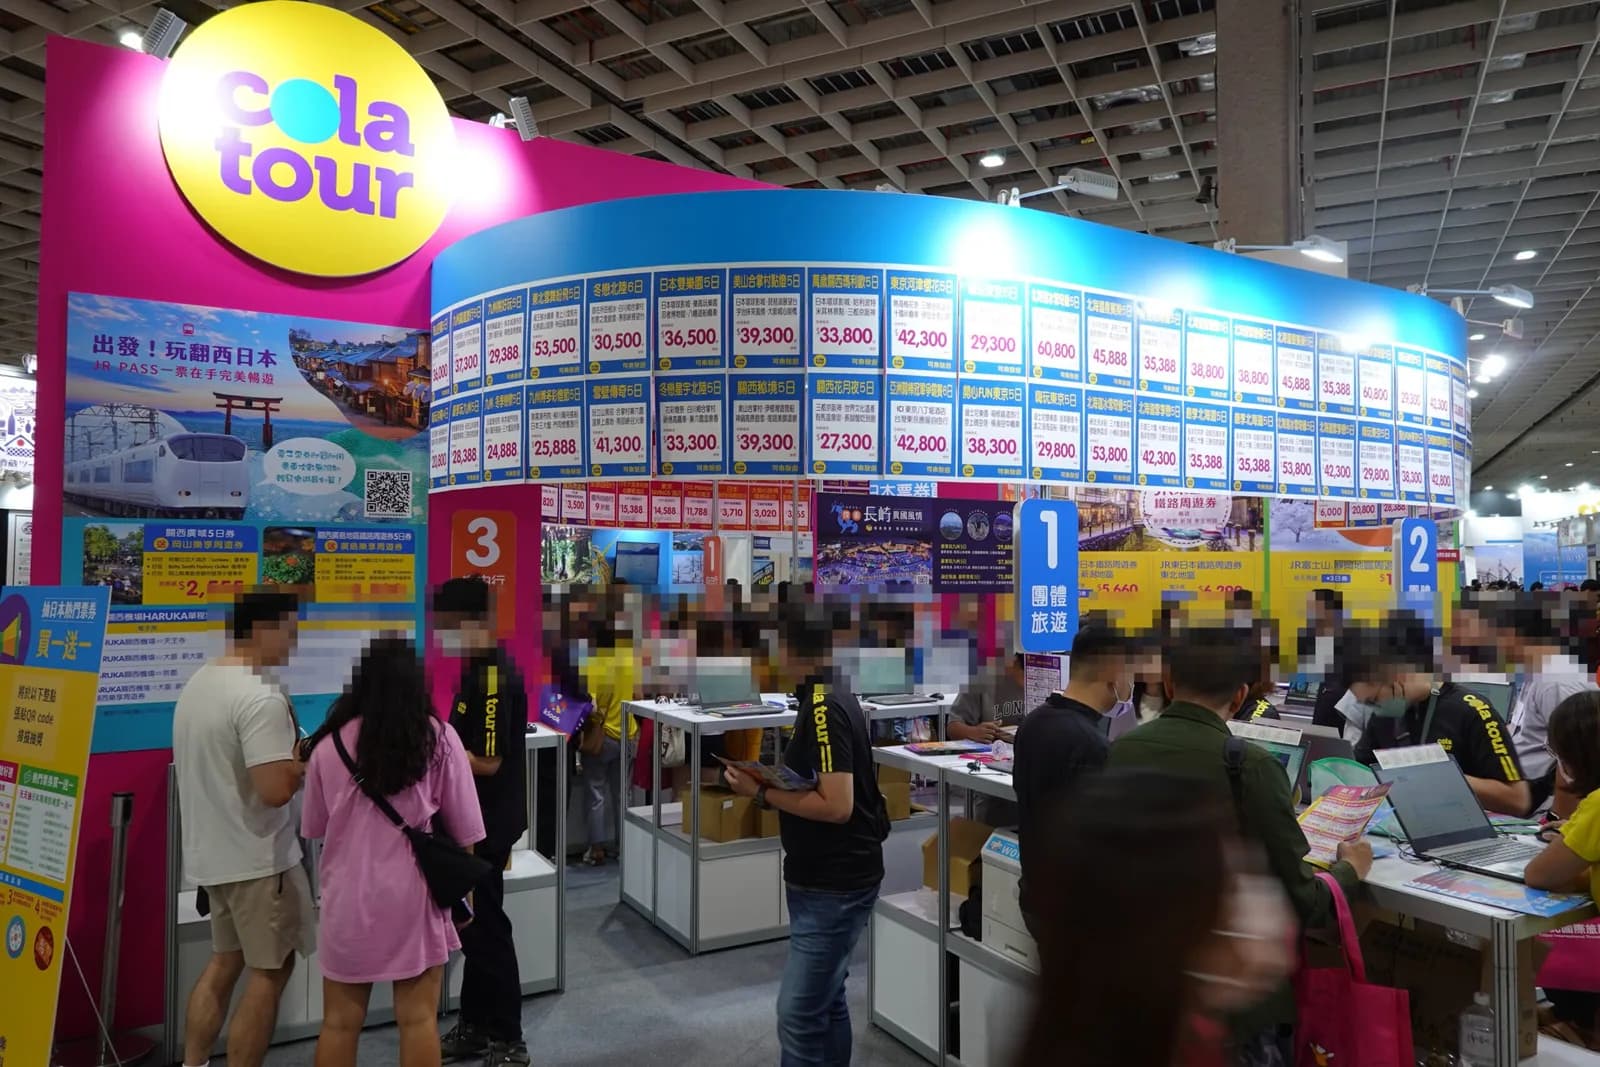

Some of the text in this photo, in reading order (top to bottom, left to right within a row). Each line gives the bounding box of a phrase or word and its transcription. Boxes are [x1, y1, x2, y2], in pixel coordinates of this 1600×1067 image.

[216, 70, 415, 157] cola
[214, 126, 414, 219] tour
[594, 331, 642, 350] 30,500
[664, 328, 717, 347] 36,500
[740, 326, 794, 346] 39,300
[819, 326, 874, 345] 33,800
[897, 329, 948, 348] 42,300
[970, 334, 1016, 353] 29,300
[92, 334, 278, 368] 出發！玩翻西日本
[489, 344, 519, 364] 29,388
[534, 337, 576, 357] 53,500
[1037, 340, 1076, 359] 60,800
[1093, 347, 1127, 366] 45,888
[93, 360, 111, 372] JR
[455, 353, 478, 374] 37,300
[1144, 355, 1176, 373] 35,388
[1191, 362, 1224, 380] 38,800
[1238, 369, 1269, 386] 38,800
[1282, 375, 1310, 391] 45,888
[1322, 379, 1351, 396] 35,388
[1363, 385, 1388, 401] 60,800
[487, 442, 517, 461] 24,888
[534, 438, 576, 457] 25,888
[595, 435, 642, 455] 41,300
[666, 433, 717, 453] 33,300
[740, 433, 794, 452] 39,300
[820, 432, 873, 452] 27,300
[896, 434, 947, 453] 42,800
[968, 437, 1017, 456] 38,300
[1038, 440, 1076, 459] 29,800
[452, 447, 477, 465] 28,388
[1092, 445, 1127, 463] 53,800
[1142, 449, 1176, 468] 42,300
[1190, 453, 1222, 470] 35,388
[1239, 457, 1270, 474] 35,388
[1282, 461, 1311, 476] 53,800
[1324, 464, 1351, 479] 42,300
[1363, 467, 1389, 482] 29,800
[567, 499, 585, 510] 3,500
[621, 504, 643, 515] 15,388
[654, 506, 676, 515] 14,588
[721, 508, 743, 518] 3,710
[754, 508, 777, 518] 3,020
[1352, 503, 1376, 515] 20,800
[465, 517, 500, 568] 3
[1039, 509, 1058, 570] 1
[708, 540, 716, 572] 1
[1409, 526, 1430, 573] 2
[1031, 585, 1068, 608] 團體
[1031, 610, 1068, 634] 旅遊
[35, 628, 93, 662] 買一送一
[37, 711, 54, 726] code
[485, 698, 498, 730] tour
[814, 705, 830, 744] tour
[1463, 694, 1508, 756] cola tour
